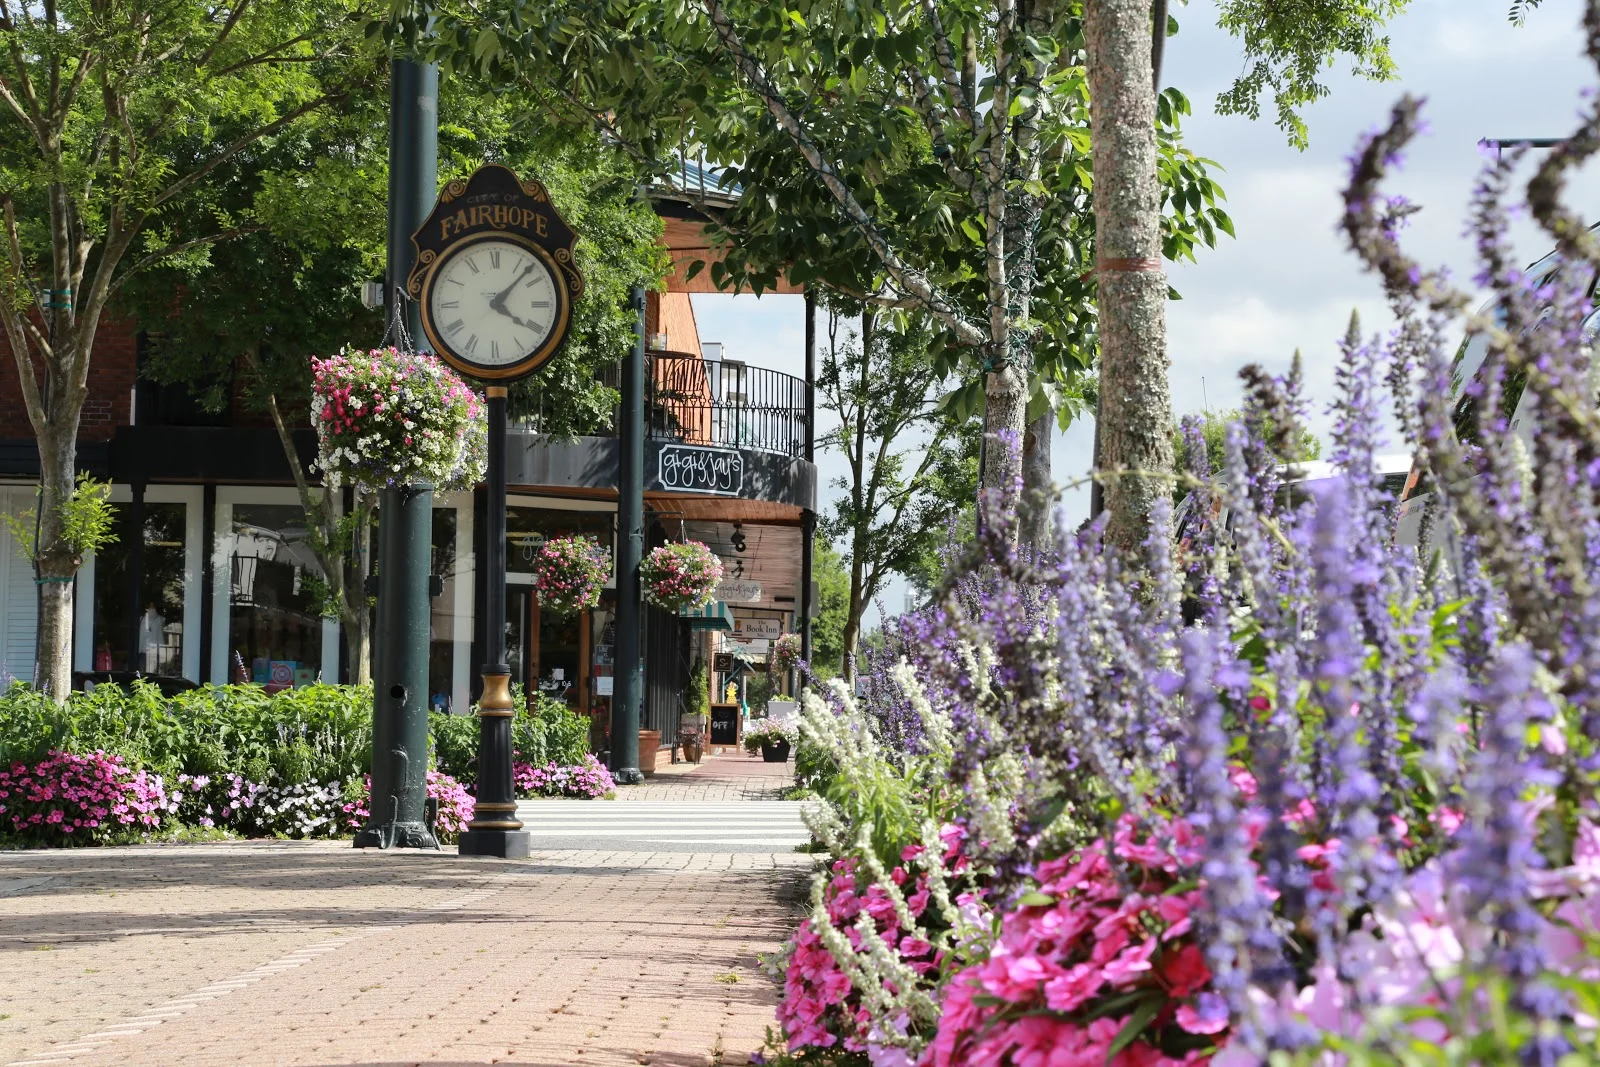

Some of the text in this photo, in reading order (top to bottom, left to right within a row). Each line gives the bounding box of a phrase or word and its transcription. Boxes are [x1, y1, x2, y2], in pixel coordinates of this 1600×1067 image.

[503, 193, 520, 203] OF
[440, 204, 549, 240] FAIRHOPE
[746, 624, 778, 634] Book Inn
